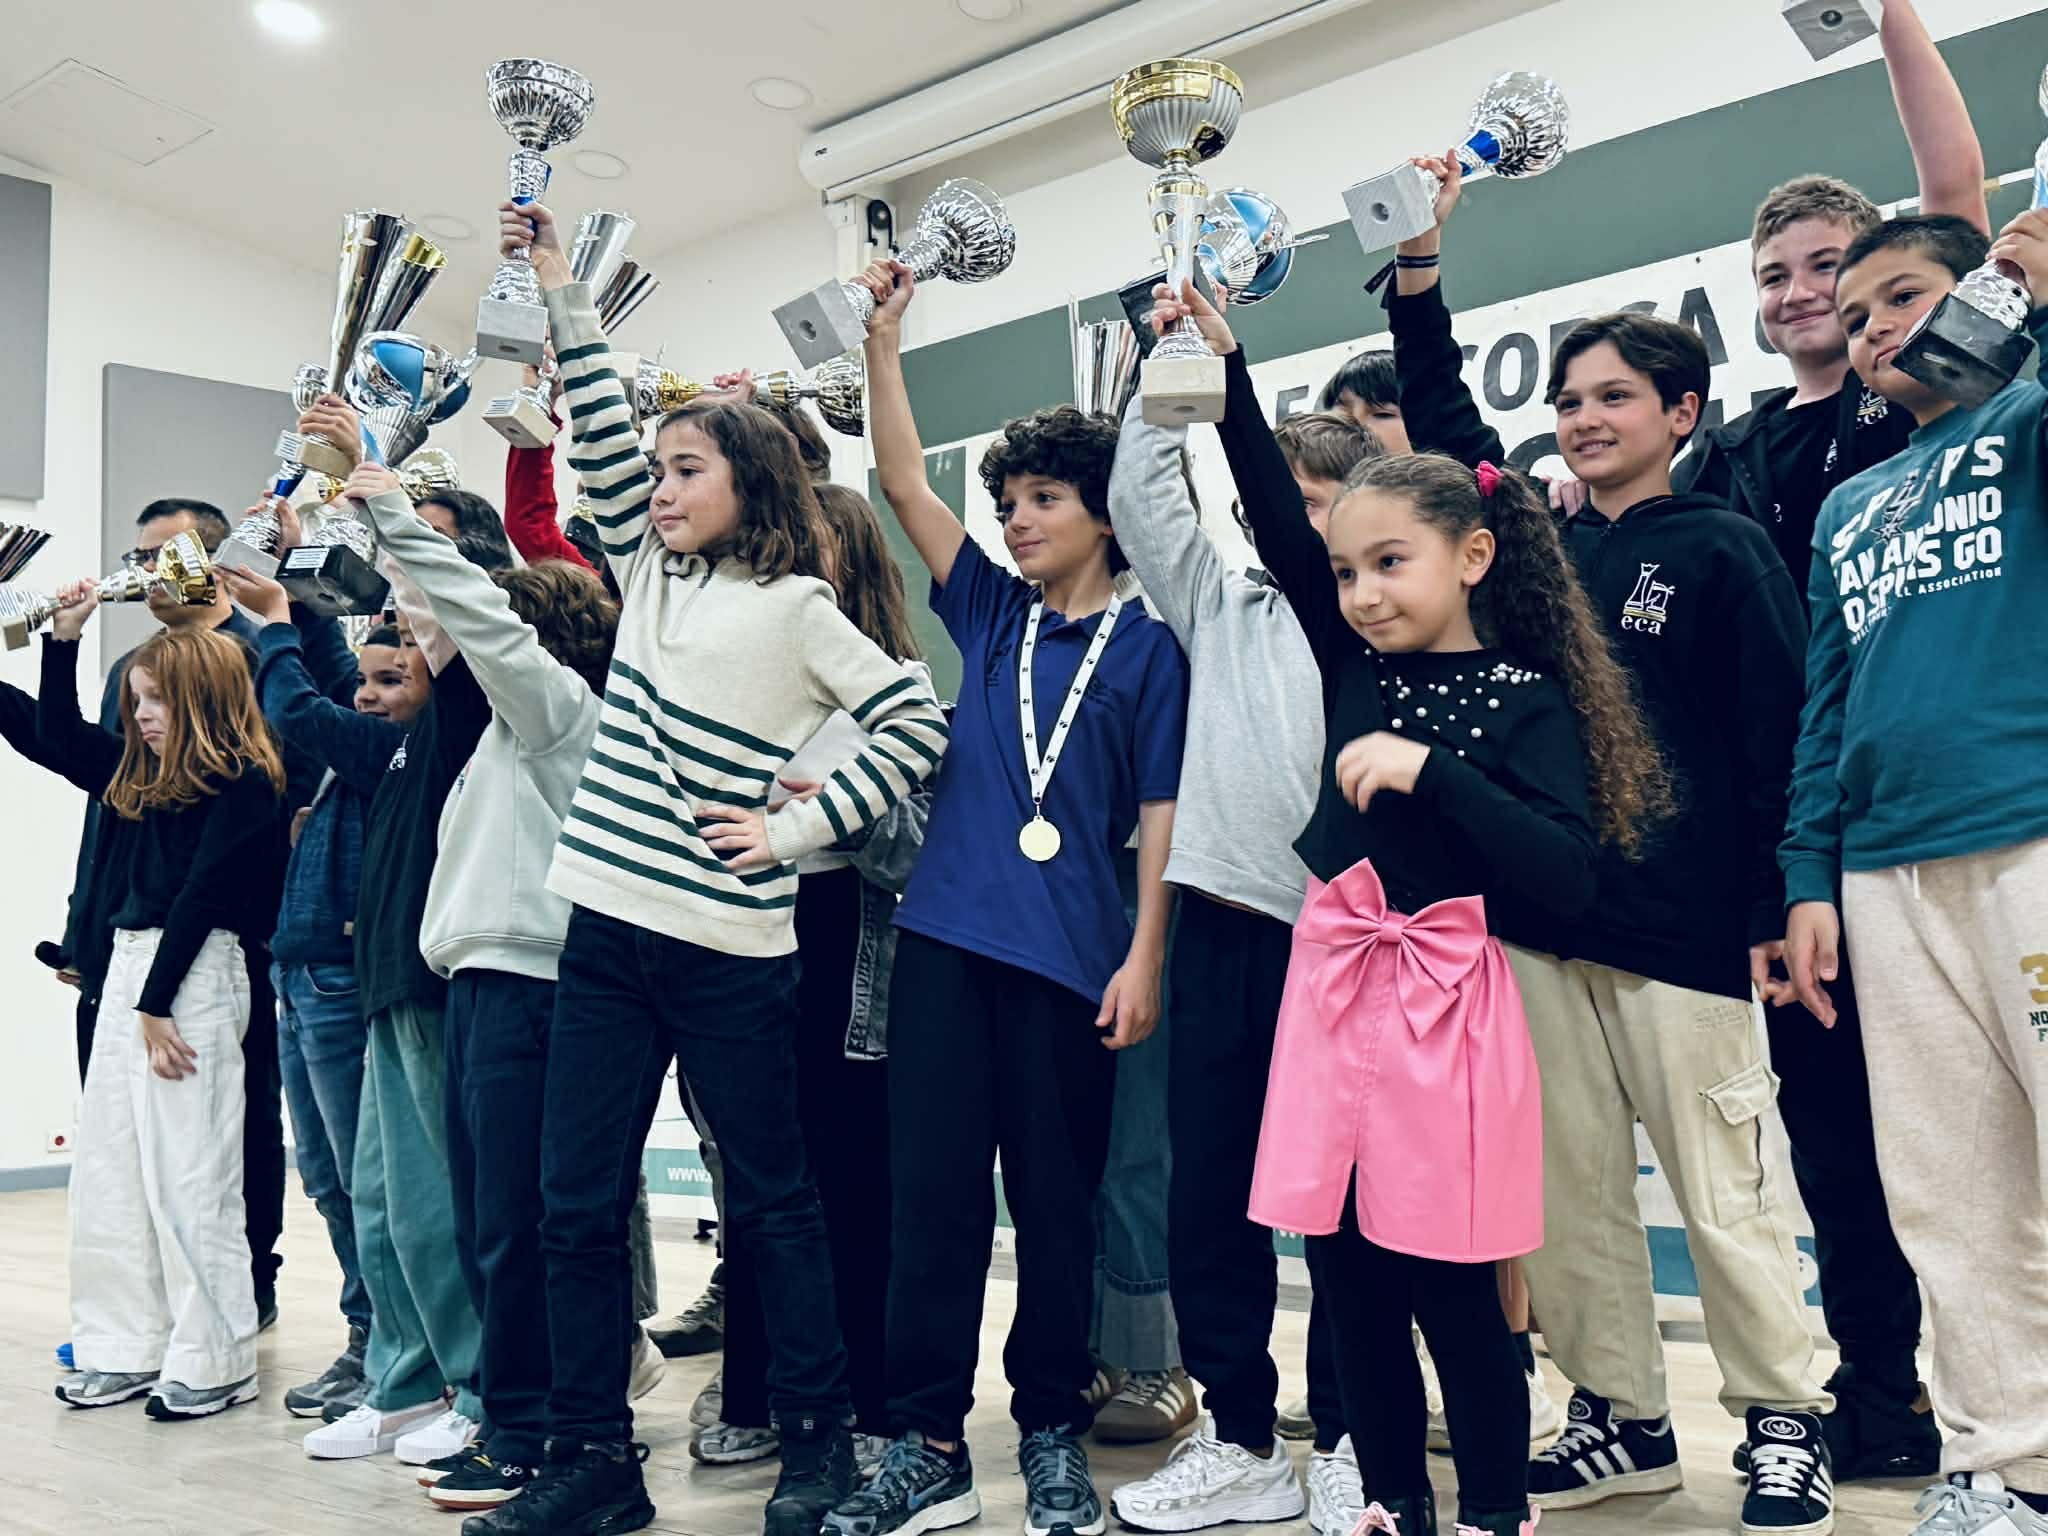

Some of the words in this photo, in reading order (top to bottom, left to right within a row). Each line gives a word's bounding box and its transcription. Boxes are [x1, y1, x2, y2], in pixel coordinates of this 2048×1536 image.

[1953, 526, 2003, 570] GO
[1833, 547, 1875, 596] AN
[1918, 567, 2002, 594] ASSOCIATION
[1620, 615, 1662, 635] eca
